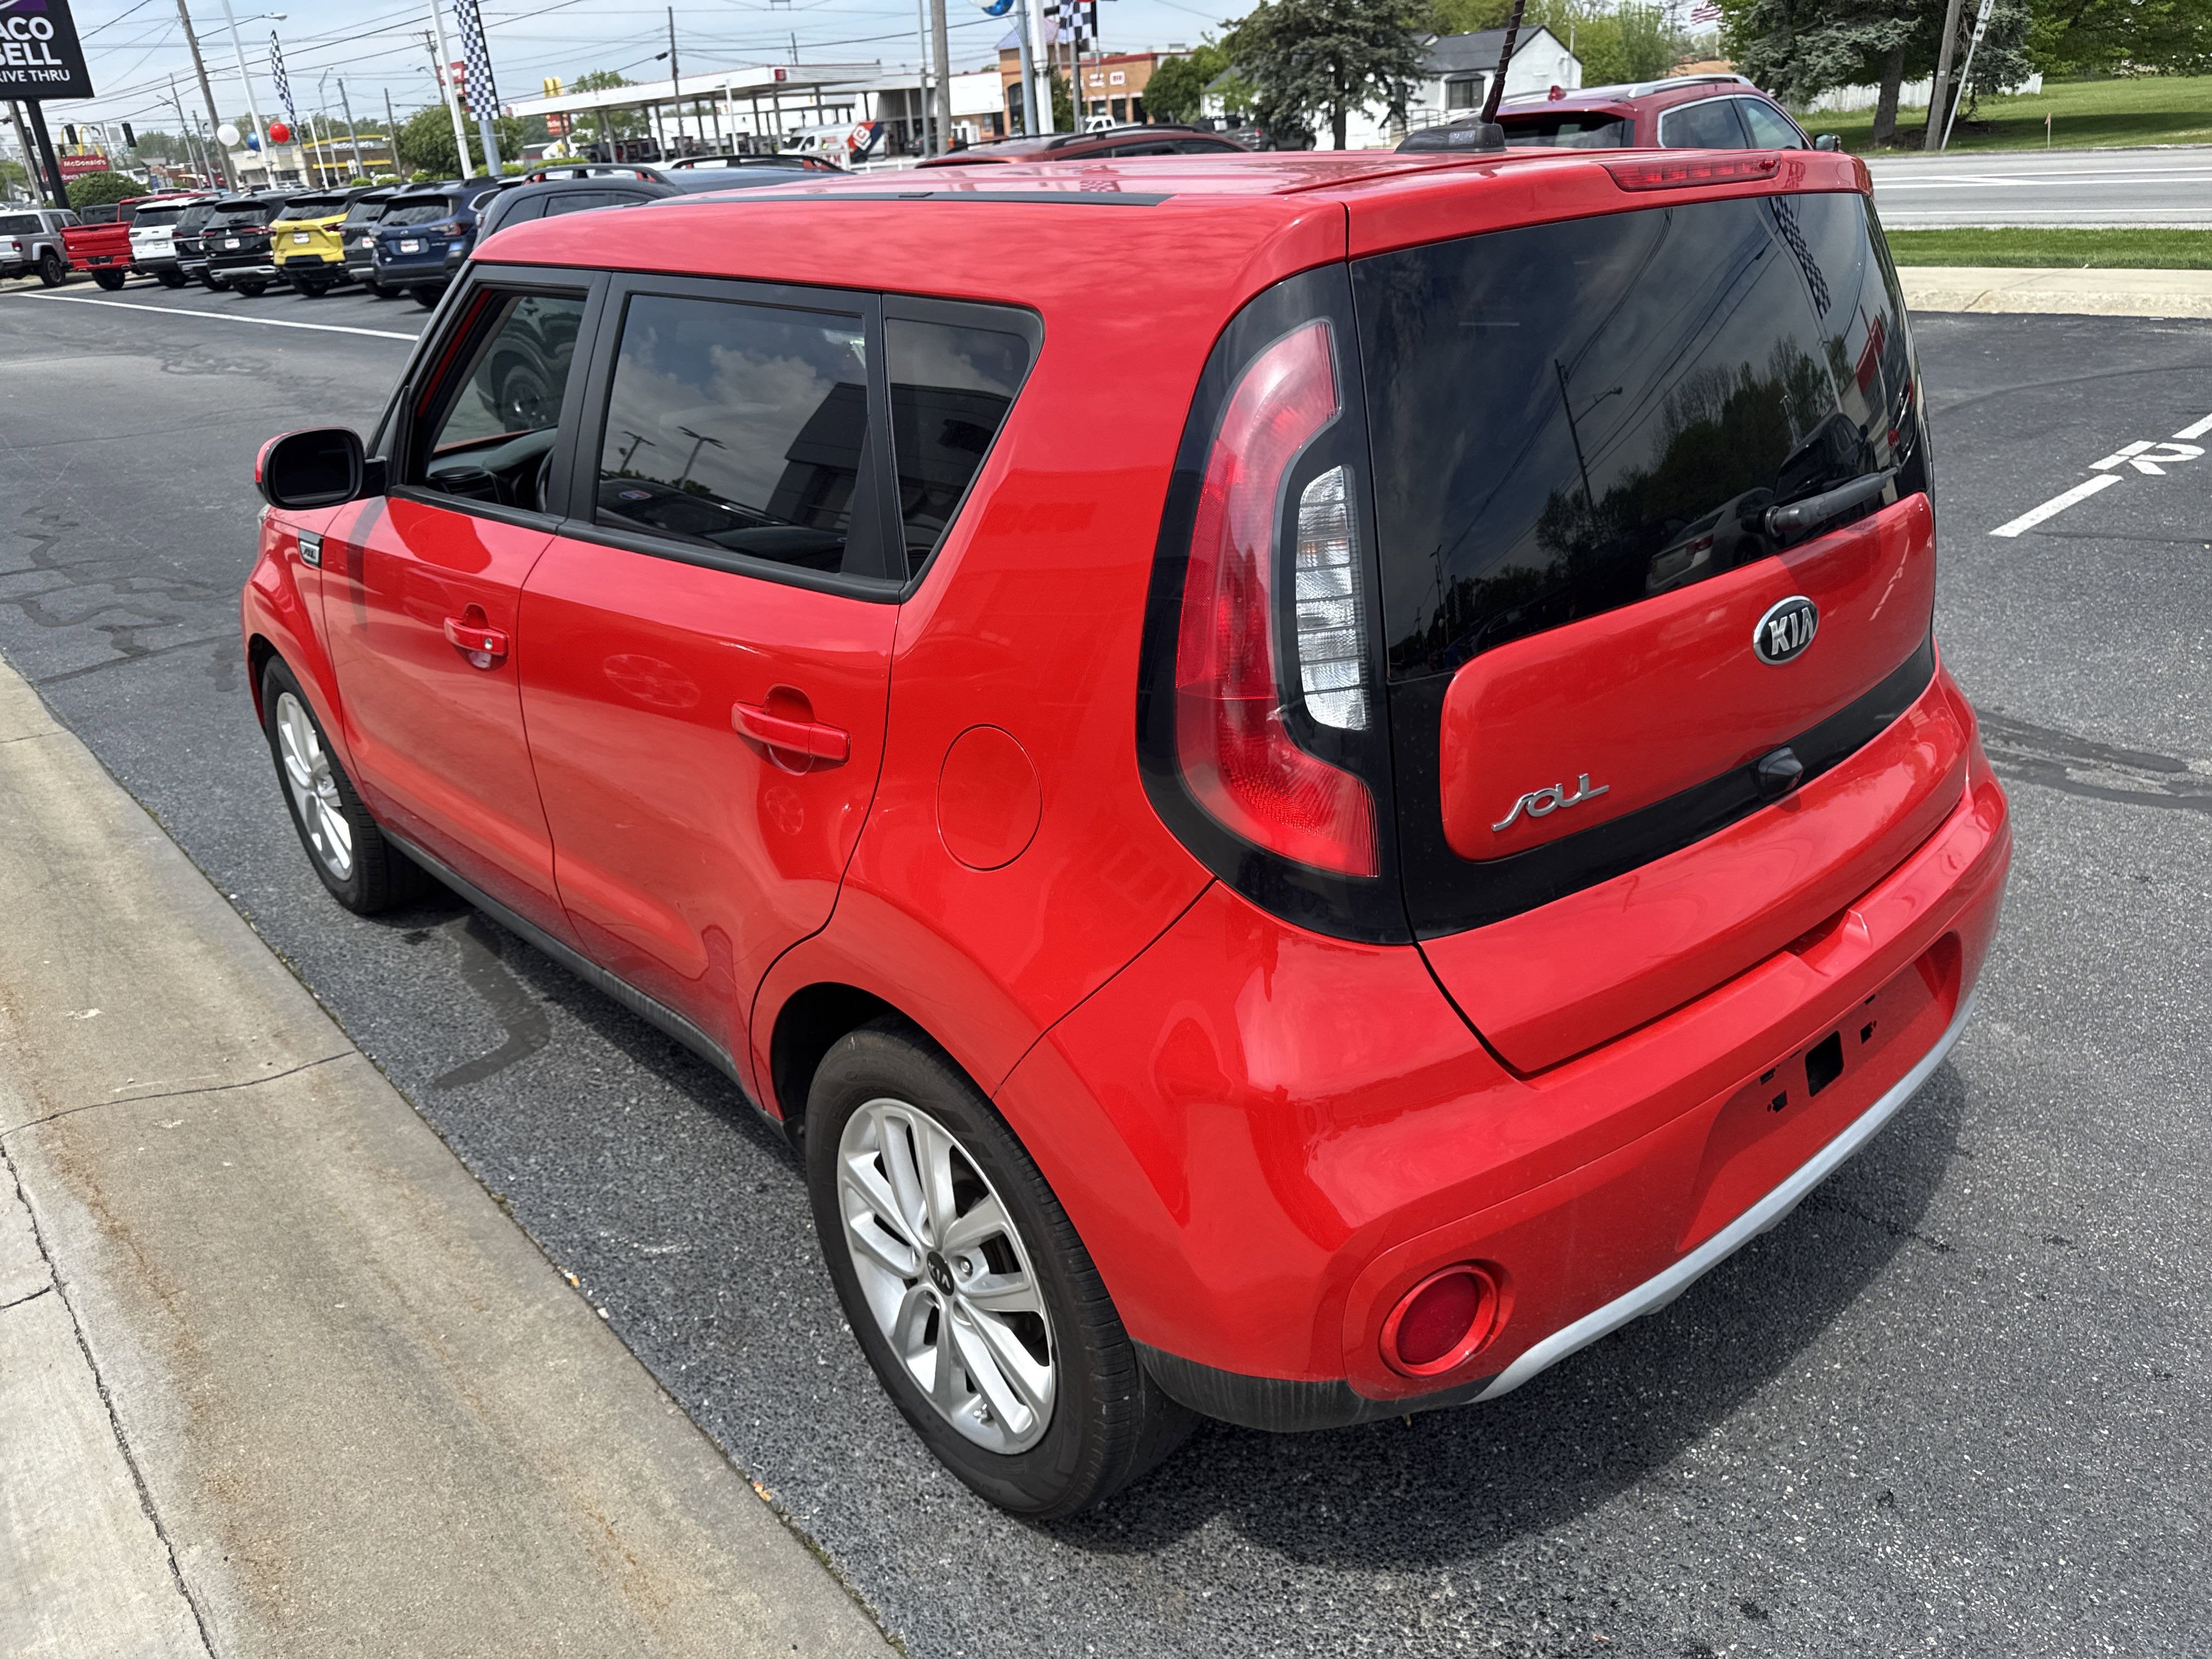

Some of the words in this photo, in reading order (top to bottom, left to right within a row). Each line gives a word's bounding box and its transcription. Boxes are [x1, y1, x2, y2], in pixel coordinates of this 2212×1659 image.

[0, 16, 54, 41] ACO
[28, 69, 71, 82] THRU
[1768, 606, 1813, 656] KIA
[928, 1260, 951, 1290] KIA
